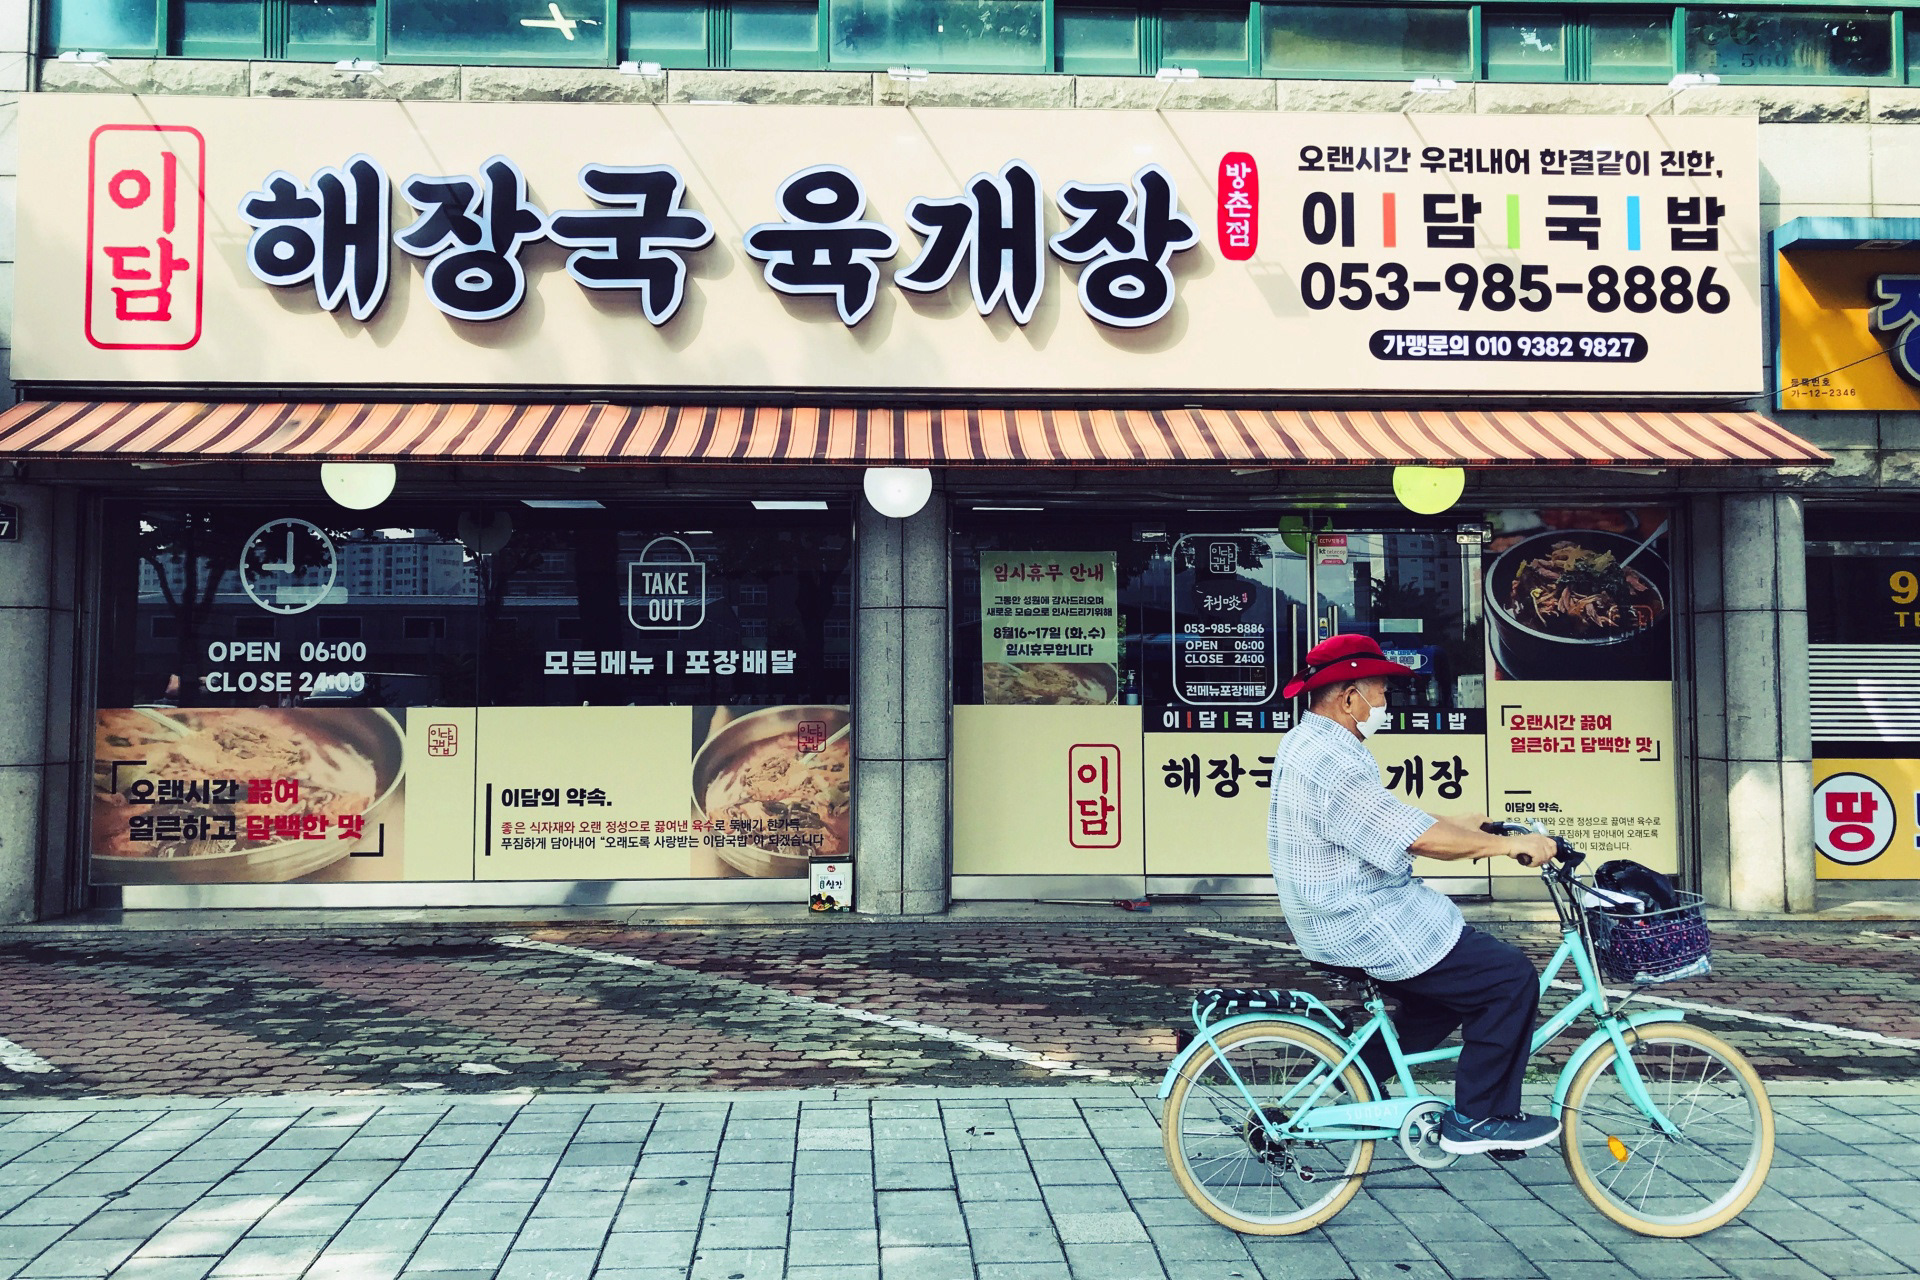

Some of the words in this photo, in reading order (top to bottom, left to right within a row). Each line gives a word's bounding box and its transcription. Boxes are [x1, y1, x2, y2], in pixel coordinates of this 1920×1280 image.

[1298, 145, 1411, 172] 오랜시간
[1420, 146, 1530, 175] 우려내어
[1540, 148, 1650, 176] 한결같이
[1661, 150, 1723, 178] 진한,
[1224, 161, 1252, 247] 방촌점
[1302, 191, 1355, 248] 이
[1423, 193, 1482, 249] 담
[1545, 195, 1601, 251] 국
[1667, 196, 1726, 251] 밥
[104, 151, 189, 322] 이담
[239, 153, 716, 326] 해장국
[743, 159, 1200, 327] 육개장
[1300, 262, 1730, 314] 053-985-8886
[1383, 335, 1469, 356] 가맹문의
[1475, 336, 1511, 356] 010
[1517, 337, 1574, 357] 9382
[1580, 338, 1635, 358] 9827
[1791, 388, 1856, 397] 가-12-2346
[993, 563, 1063, 582] 임시휴무
[1070, 563, 1104, 582] 안내
[642, 572, 689, 594] TAKE
[648, 599, 684, 621] OUT
[994, 596, 1021, 605] 그동안
[1023, 596, 1049, 605] 성원에
[1052, 596, 1104, 605] 감사드리오며
[986, 607, 1012, 616] 새로운
[1015, 608, 1050, 616] 모습으로
[1052, 607, 1112, 616] 인사드리기위해
[993, 627, 1061, 639] 8월16~17일
[1065, 627, 1105, 639] (화,수)
[1184, 624, 1265, 633] 053-985-8886
[208, 641, 280, 662] OPEN
[300, 641, 367, 662] 06:00
[1006, 643, 1093, 656] 임시휴무합니다
[1185, 641, 1218, 650] OPEN
[1234, 641, 1265, 650] 06:00
[543, 650, 655, 675] 모든메뉴
[685, 649, 796, 675] 포장배달
[1185, 654, 1224, 664] CLOSE
[1234, 654, 1265, 664] 24:00
[205, 671, 292, 692] CLOSE
[299, 671, 365, 692] 24:00
[1186, 685, 1266, 697] 전메뉴포장배달
[1163, 711, 1179, 728] 이
[1198, 711, 1217, 729] 담
[1235, 711, 1253, 729] 국
[1272, 711, 1290, 729] 밥
[1411, 712, 1429, 730] 국
[1448, 712, 1466, 730] 밥
[1510, 715, 1575, 730] 오랜시간
[1580, 715, 1612, 730] 끓여
[1511, 737, 1576, 753] 얼큰하고
[1580, 737, 1630, 753] 담백한
[1636, 737, 1652, 753] 맛
[1384, 755, 1469, 799] 개장
[130, 779, 239, 804] 오랜시간
[247, 779, 300, 804] 끓여
[501, 788, 559, 807] 이담의
[566, 788, 612, 807] 약속.
[1076, 755, 1115, 836] 이담
[1505, 803, 1535, 812] 이담의
[1538, 803, 1563, 812] 약속.
[129, 815, 237, 841] 얼큰하고
[246, 815, 329, 841] 담백한
[338, 814, 364, 841] 맛
[501, 822, 525, 834] 좋은
[530, 821, 575, 834] 식자재와
[579, 821, 602, 833] 오랜
[605, 821, 650, 833] 정성으로
[654, 820, 688, 833] 끓여낸
[692, 820, 725, 832] 육수로
[729, 819, 763, 832] 뚝배기
[767, 819, 800, 832] 한가득
[1558, 817, 1574, 826] 오랜
[1577, 817, 1608, 826] 정성으로
[1611, 817, 1634, 826] 끓여낸
[1637, 817, 1661, 826] 육수로
[1825, 792, 1878, 852] 땅
[501, 837, 546, 850] 푸짐하게
[551, 837, 596, 849] 담아내어
[654, 836, 699, 848] 사랑받는
[768, 834, 824, 847] 되겠습니다
[1593, 829, 1625, 839] 담아내어
[1627, 829, 1658, 838] 오래도록
